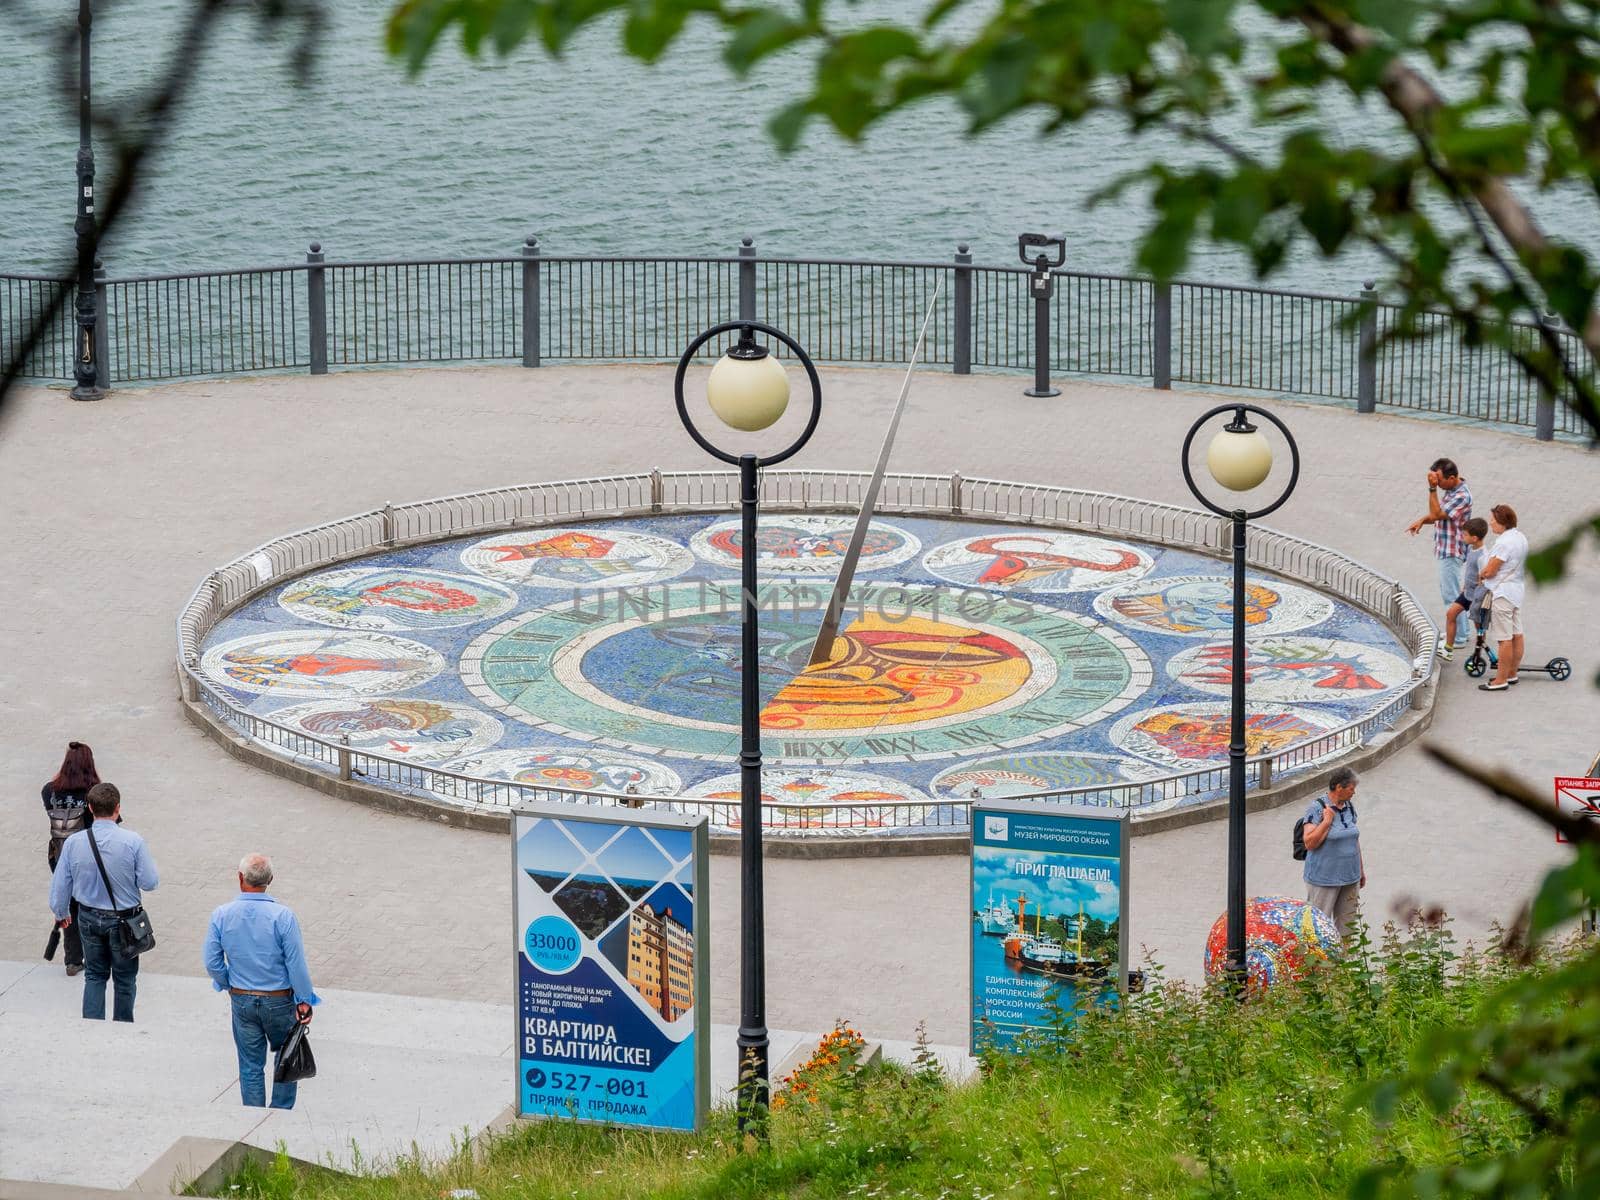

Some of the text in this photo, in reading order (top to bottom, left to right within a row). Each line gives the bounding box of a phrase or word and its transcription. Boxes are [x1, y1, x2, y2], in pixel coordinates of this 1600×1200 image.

[1014, 831, 1110, 846] МУЗЕЙ МИРОВОГО ОКЕАНА
[1015, 862, 1111, 882] ПРИГЛАШАЕМ!
[529, 933, 576, 951] 33000
[531, 982, 572, 992] ПАНОРАМНЫЙ
[596, 989, 613, 997] МОРЕ
[985, 976, 1048, 988] ЕДИНСТВЕННЫЙ
[553, 992, 588, 1002] КИРПИЧНЫЙ
[985, 987, 1045, 1000] КОМПЛЕКСНЫЙ
[562, 1001, 583, 1009] ПЛЯЖА
[985, 998, 1024, 1008] МОРСКОЙ
[992, 1010, 1024, 1018] РОССИИ
[525, 1017, 617, 1043] КВАРТИРА
[525, 1037, 651, 1066] В БАЛТИЙСКЕ!
[551, 1072, 649, 1098] 527-001
[588, 1100, 647, 1116] ПРОДАЖА
